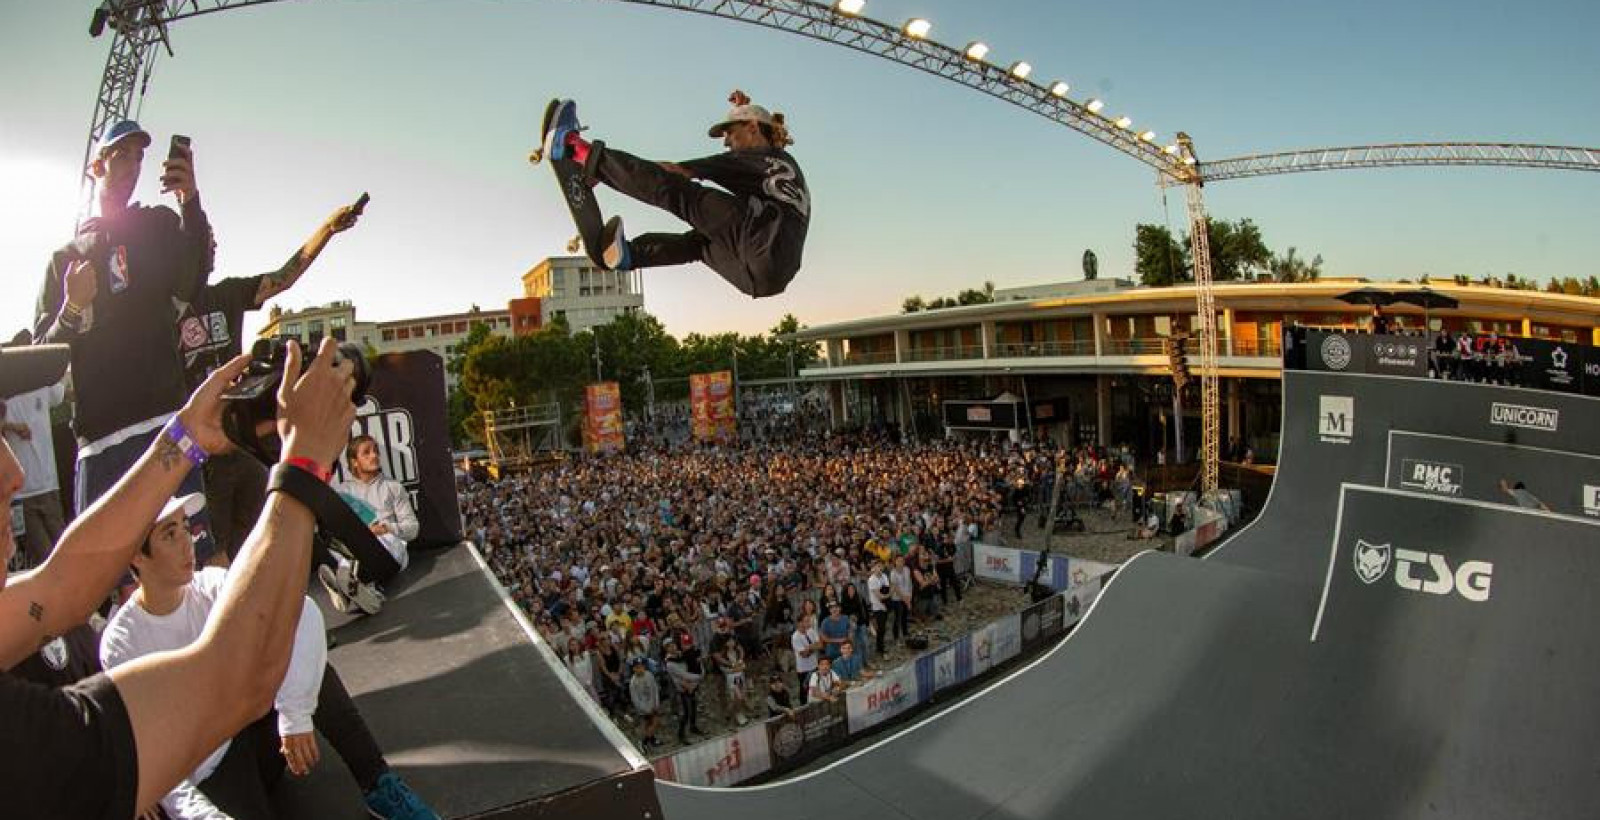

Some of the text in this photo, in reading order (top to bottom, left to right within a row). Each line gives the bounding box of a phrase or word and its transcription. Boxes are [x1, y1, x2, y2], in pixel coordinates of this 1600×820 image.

[1327, 411, 1345, 432] M
[1494, 405, 1556, 427] UNICORN
[1413, 463, 1452, 483] RMC
[1395, 547, 1494, 602] TSG
[867, 682, 903, 710] RMC
